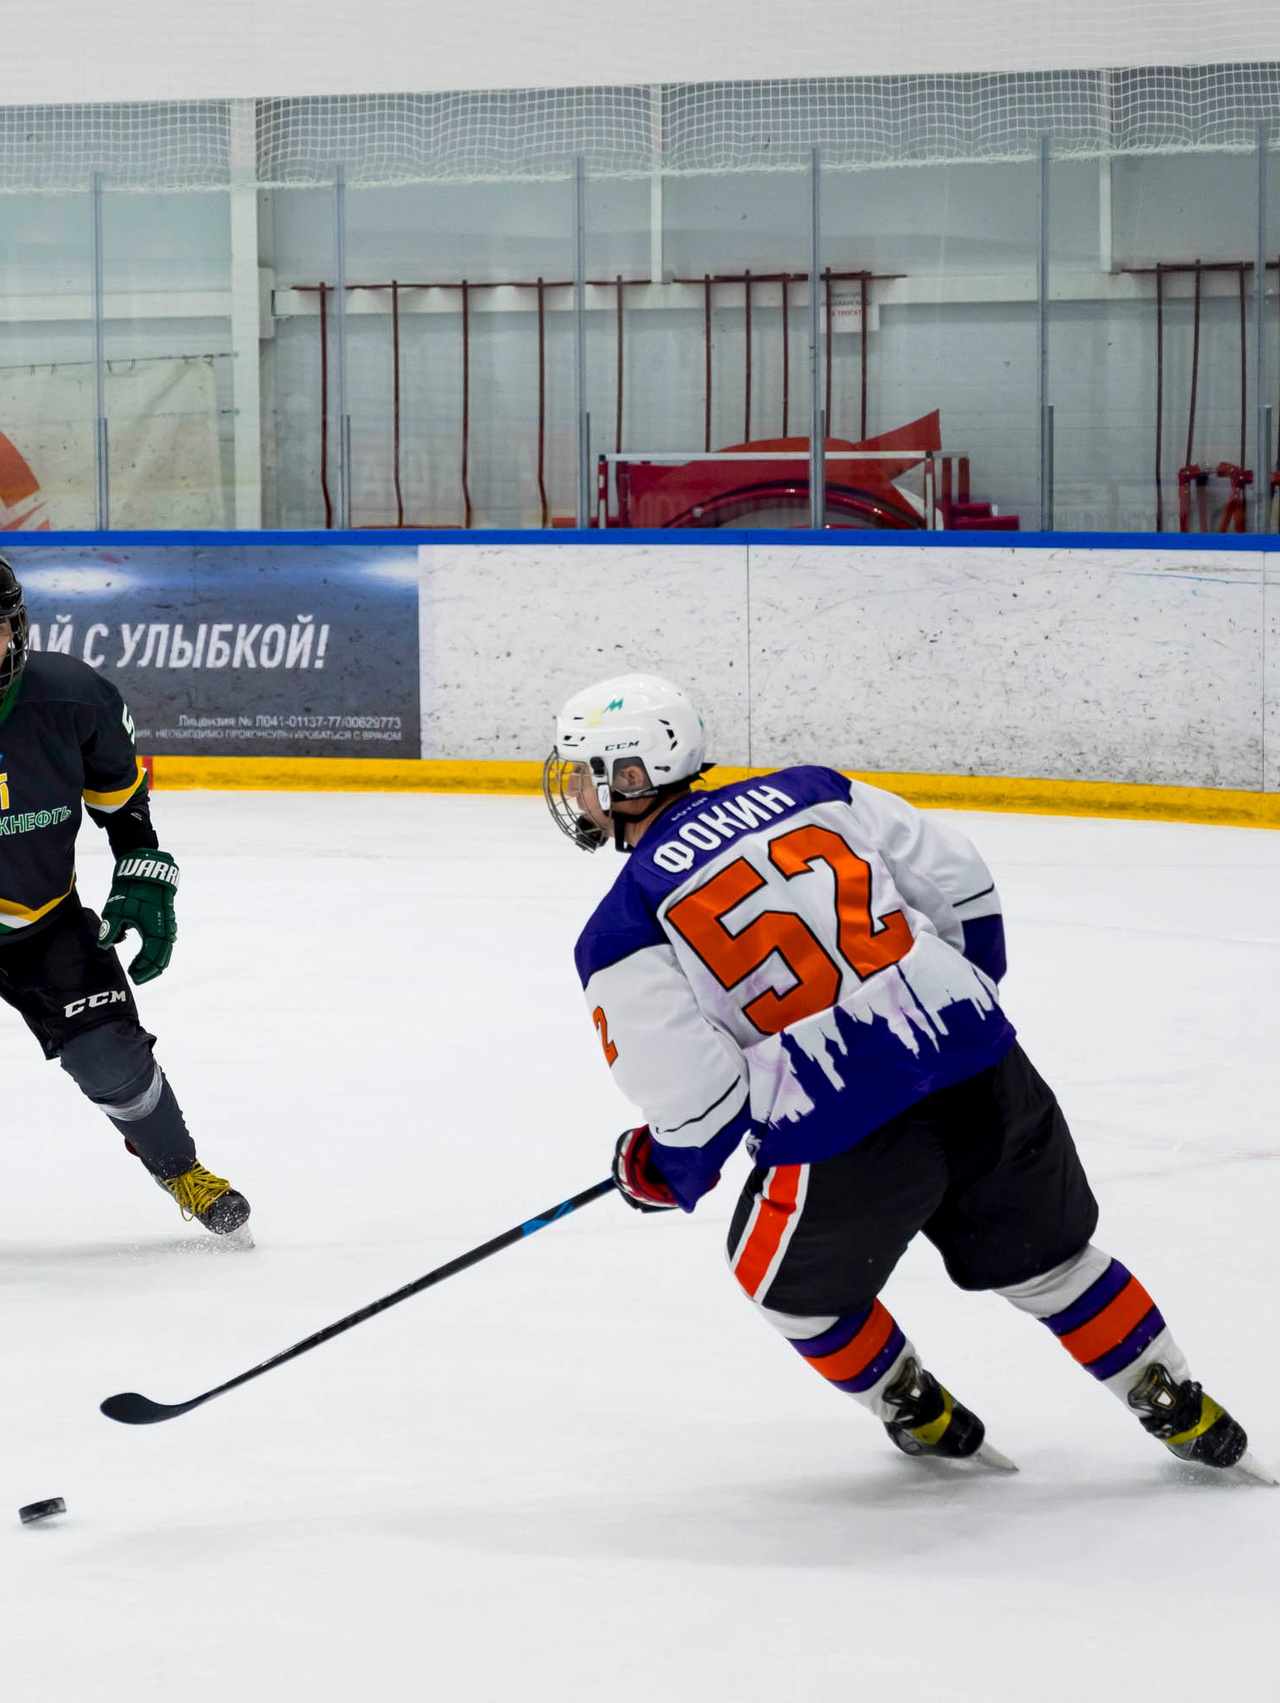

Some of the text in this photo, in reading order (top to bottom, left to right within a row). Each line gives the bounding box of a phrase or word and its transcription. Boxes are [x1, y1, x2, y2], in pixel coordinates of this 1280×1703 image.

[83, 623, 109, 668] С
[116, 615, 330, 669] УЛЫБКОЙ!
[604, 739, 641, 752] CCM
[652, 784, 797, 875] ФОКИН
[664, 823, 915, 1037] 52
[63, 990, 127, 1018] CCM
